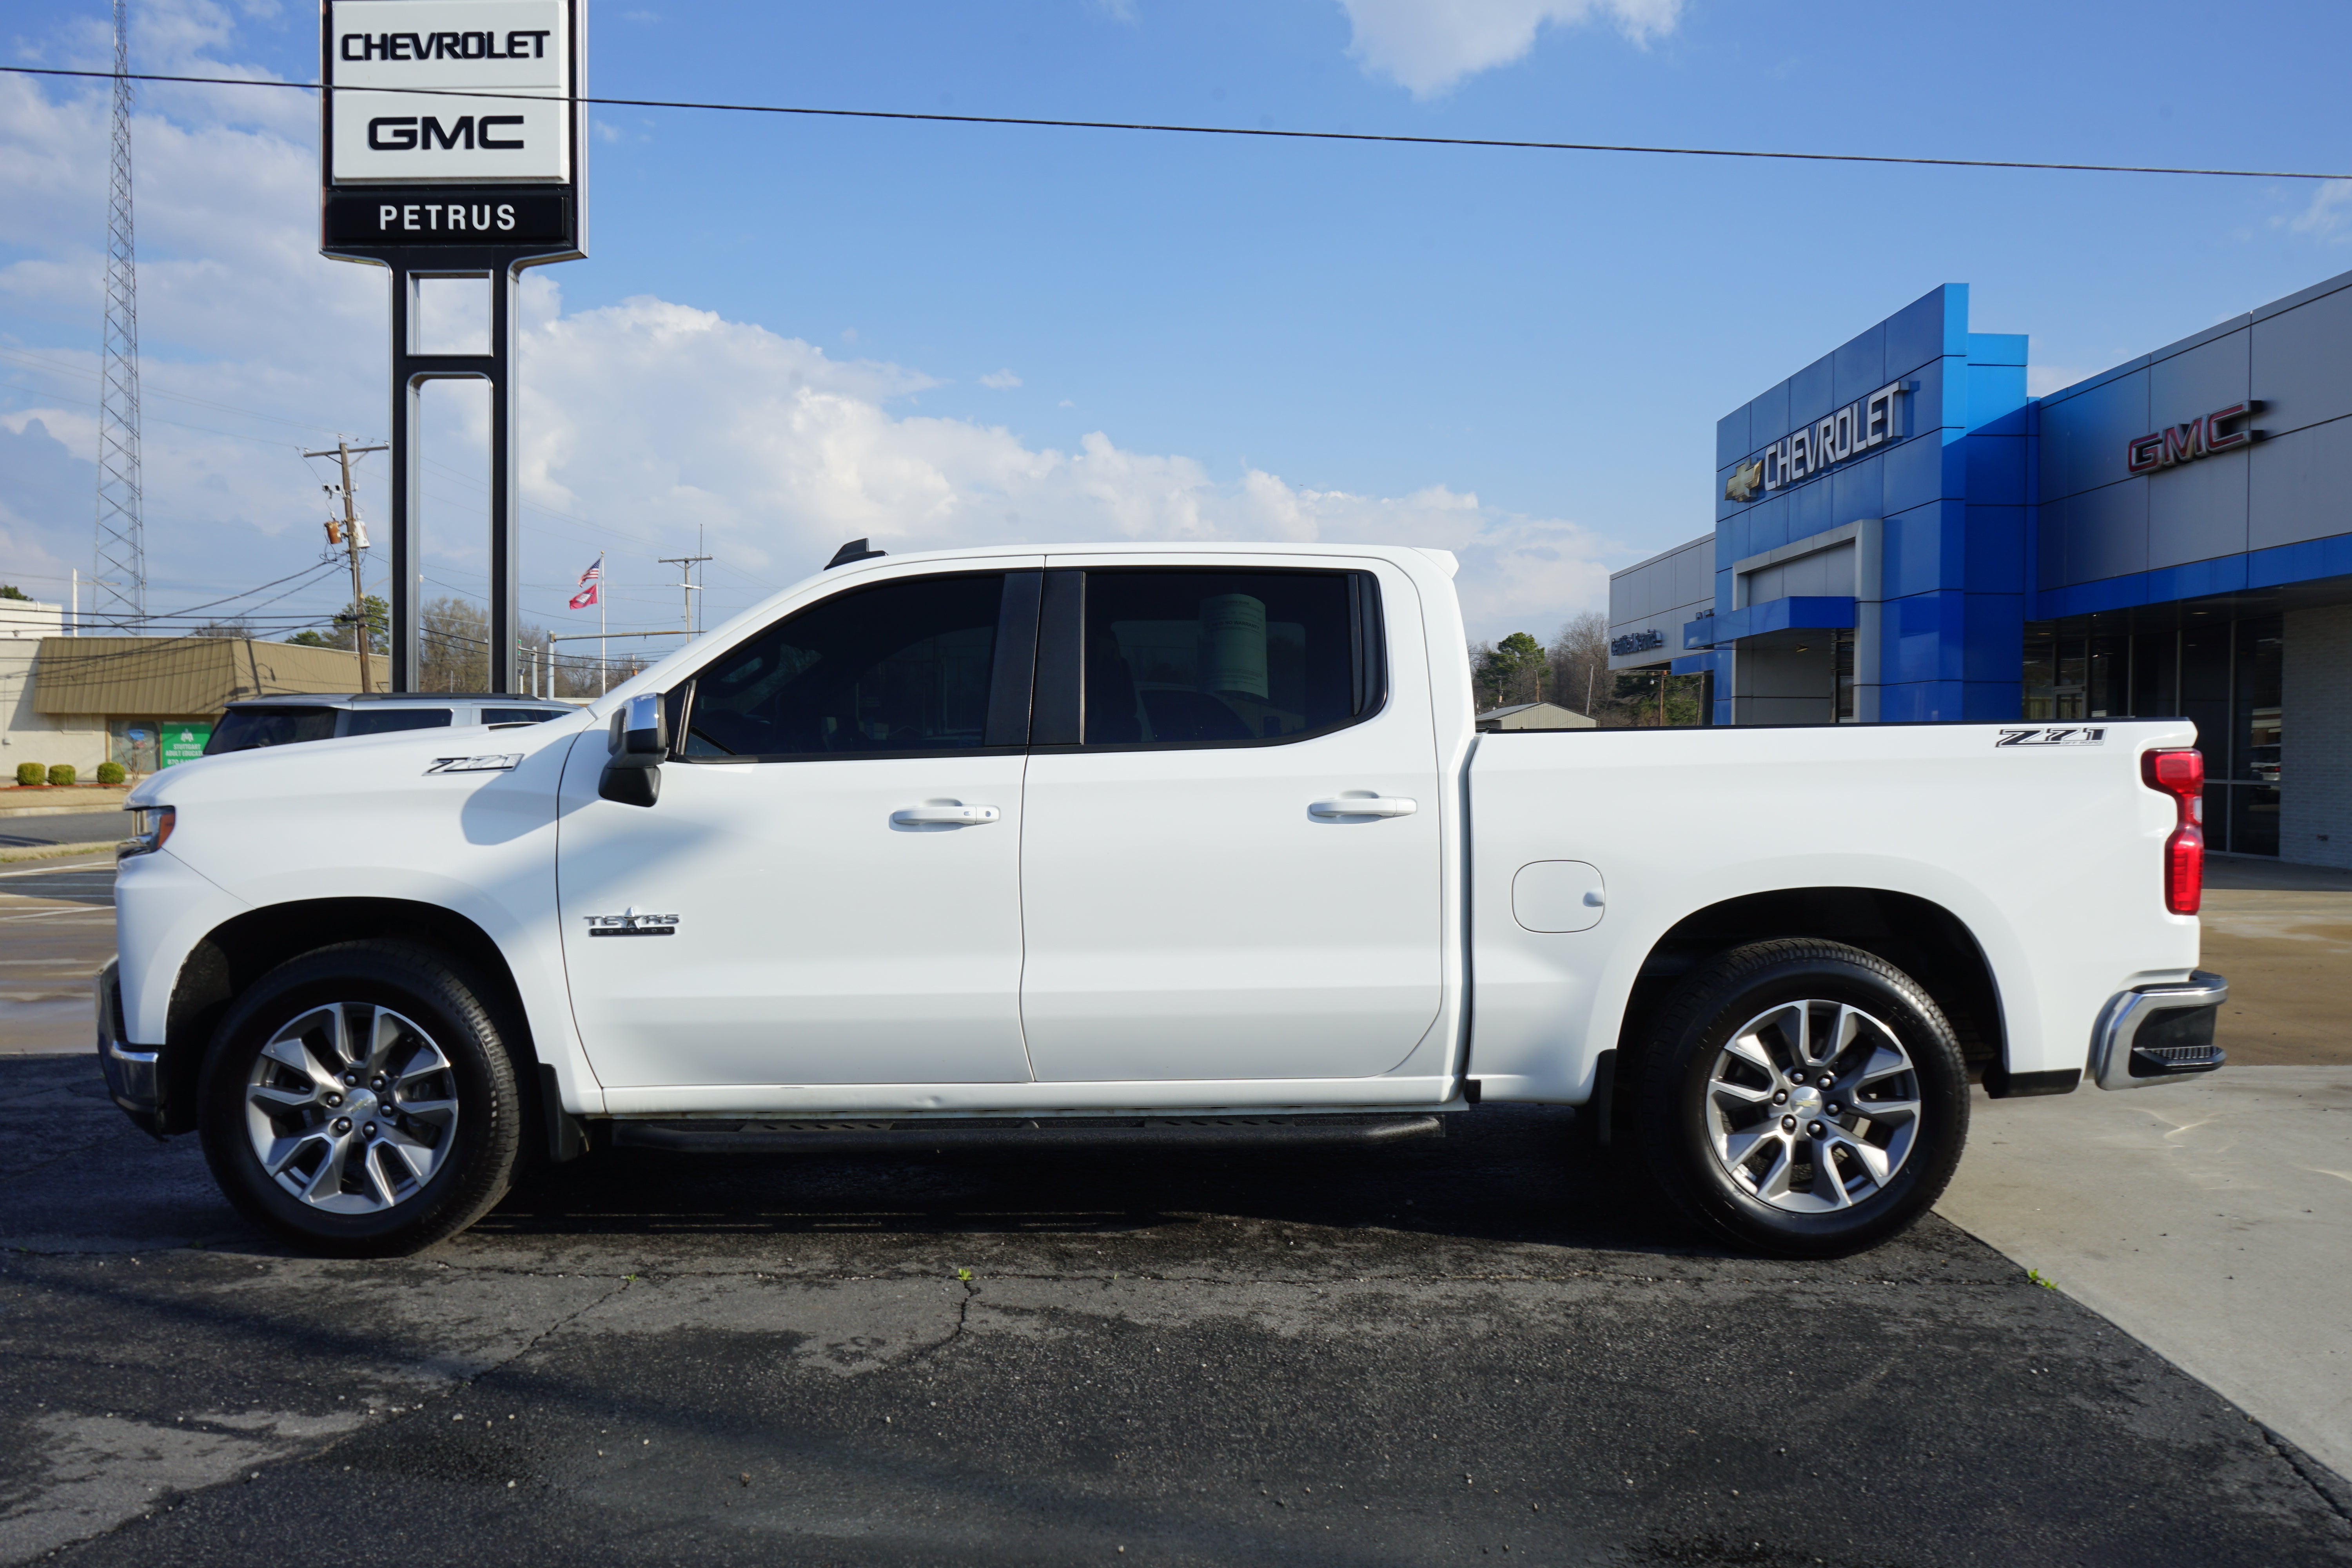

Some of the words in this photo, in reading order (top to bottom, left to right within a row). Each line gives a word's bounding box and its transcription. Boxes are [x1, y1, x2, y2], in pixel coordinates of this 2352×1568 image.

[342, 31, 550, 60] CHEVROLET
[368, 115, 524, 150] GMC
[379, 204, 515, 230] PETRUS
[1764, 381, 1908, 491] CHEVROLET
[2127, 400, 2260, 475] GMC
[1234, 621, 1259, 630] WARRANTY
[1995, 727, 2108, 748] Z71
[422, 753, 524, 776] Z71
[583, 907, 681, 929] TEXAS
